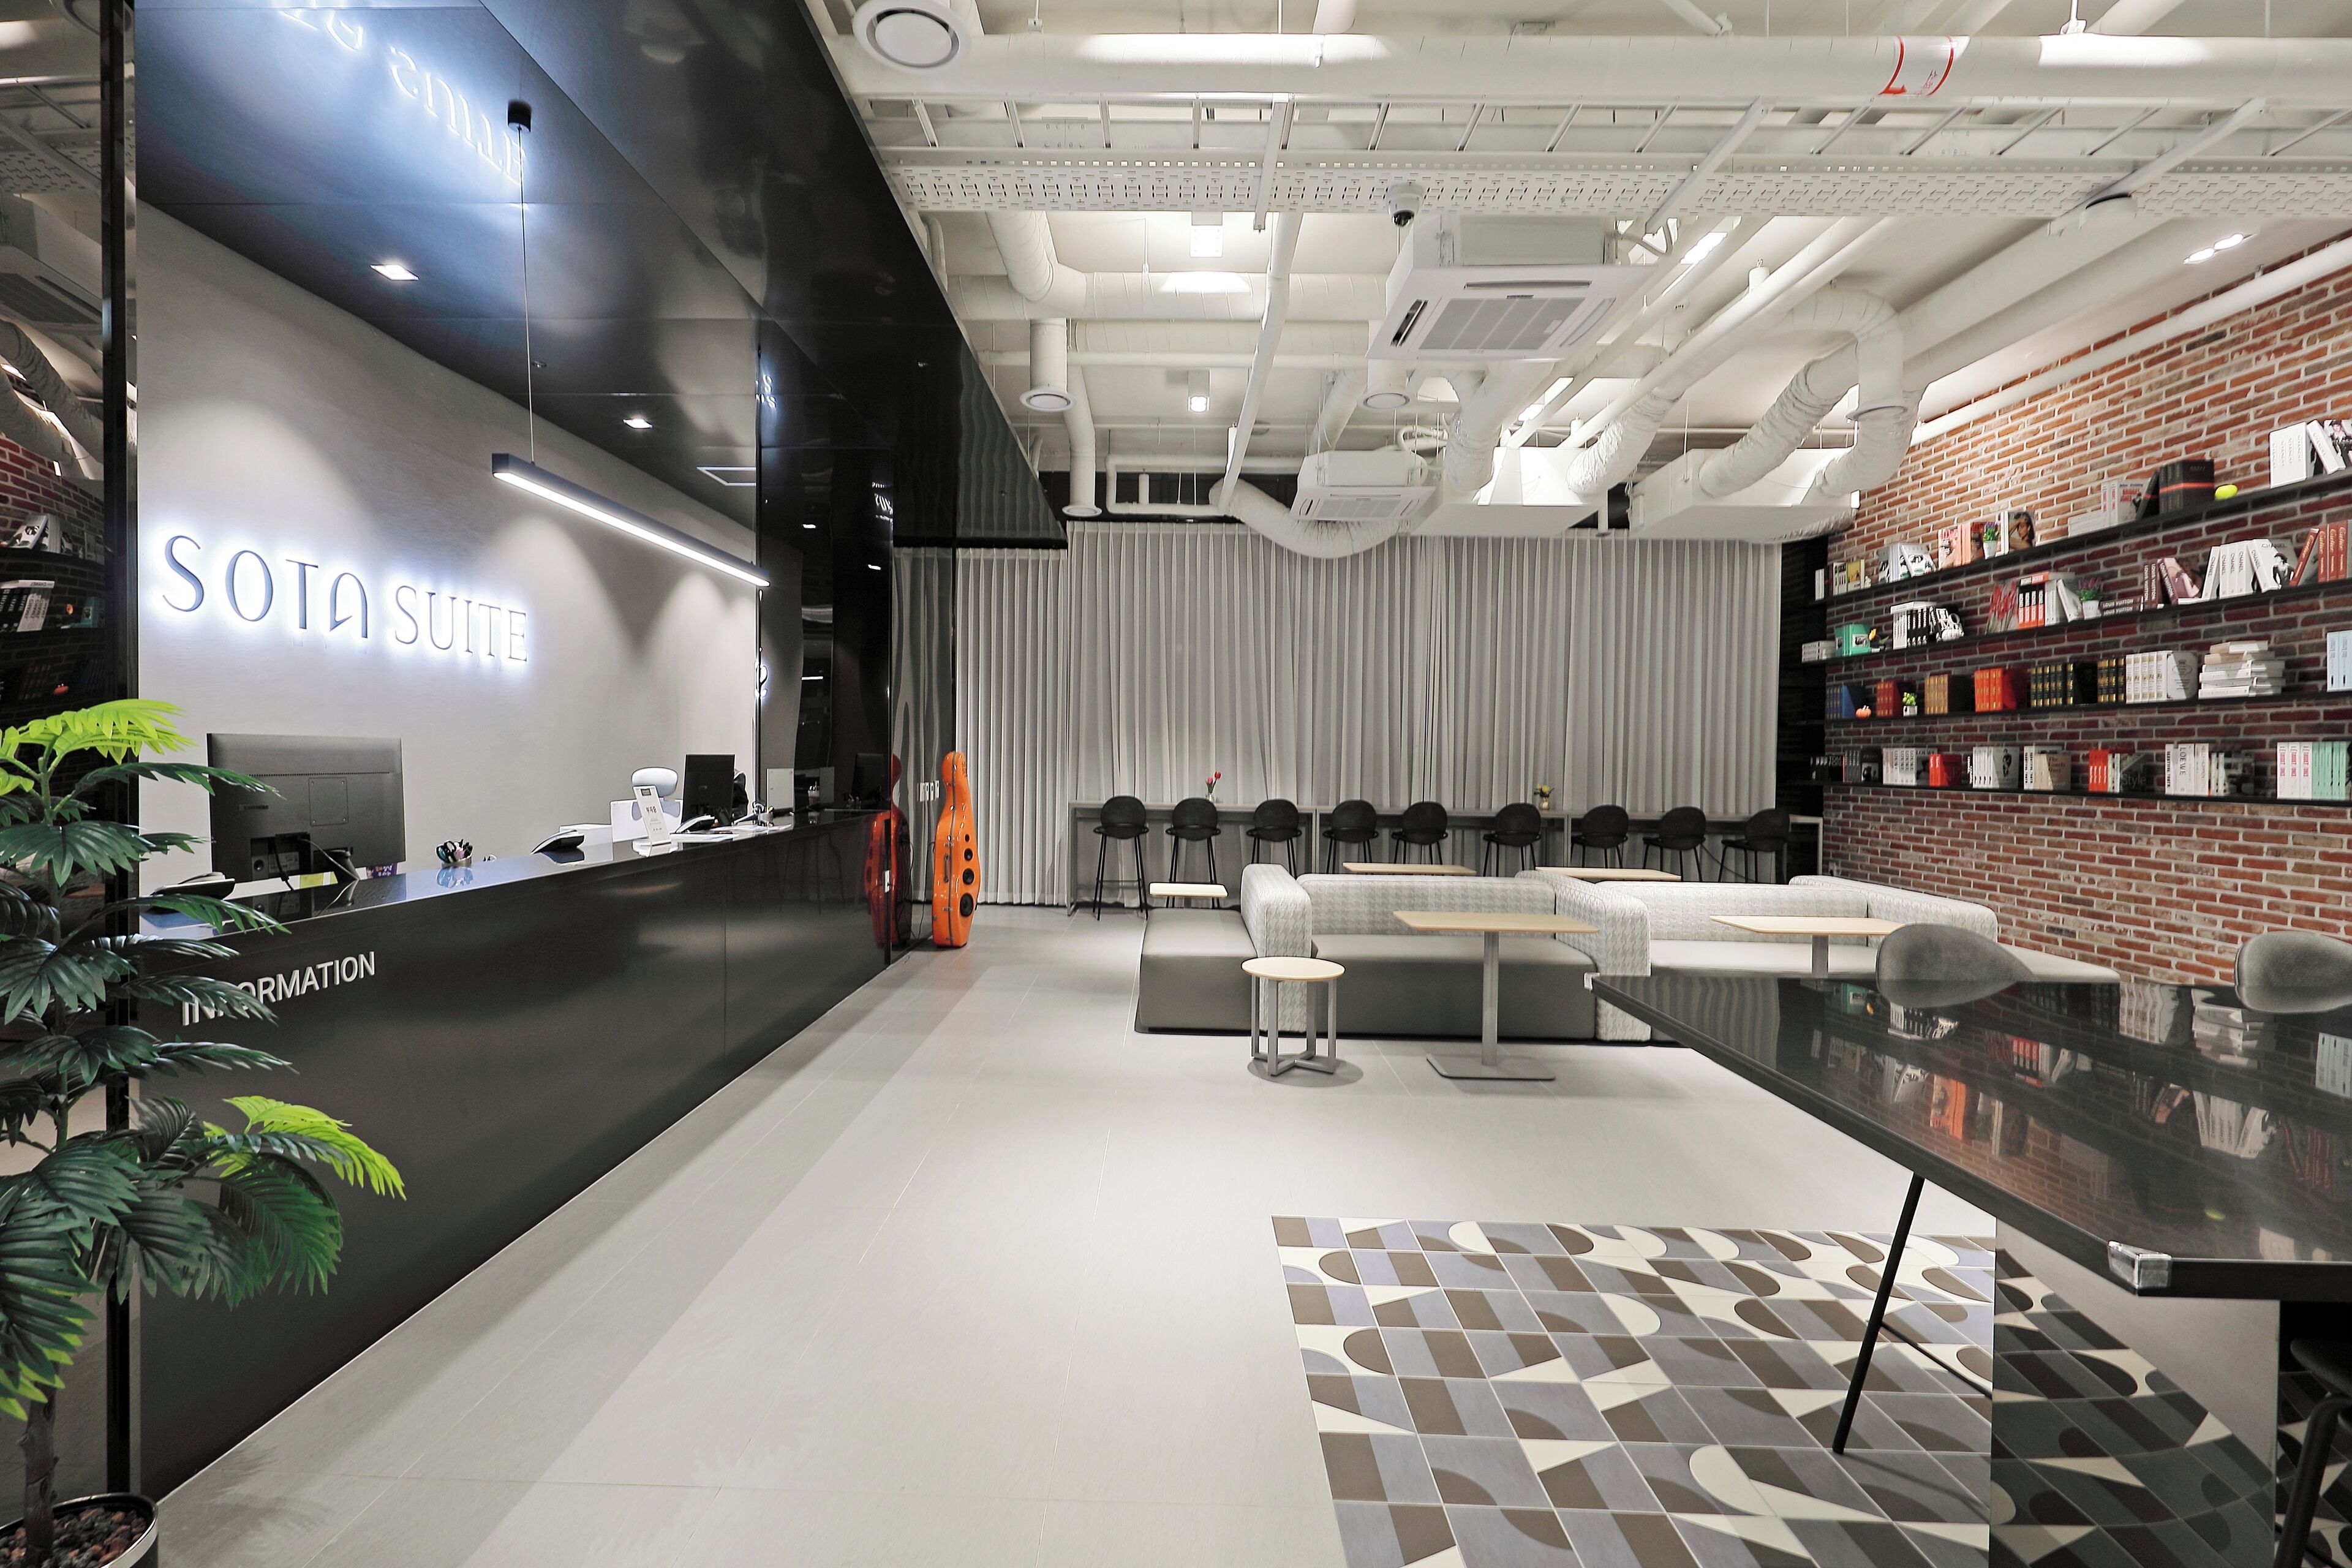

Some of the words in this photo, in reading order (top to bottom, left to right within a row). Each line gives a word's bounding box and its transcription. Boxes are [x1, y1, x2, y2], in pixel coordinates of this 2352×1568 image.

[2252, 549, 2261, 570] CHANEL
[2164, 576, 2174, 598] VUITTON
[162, 535, 368, 639] SOTA
[394, 586, 528, 662] SUITE
[2116, 598, 2133, 607] VUITTON
[2116, 606, 2133, 614] VUITTON
[2122, 773, 2146, 788] Style
[182, 951, 375, 1027] INORMATION
